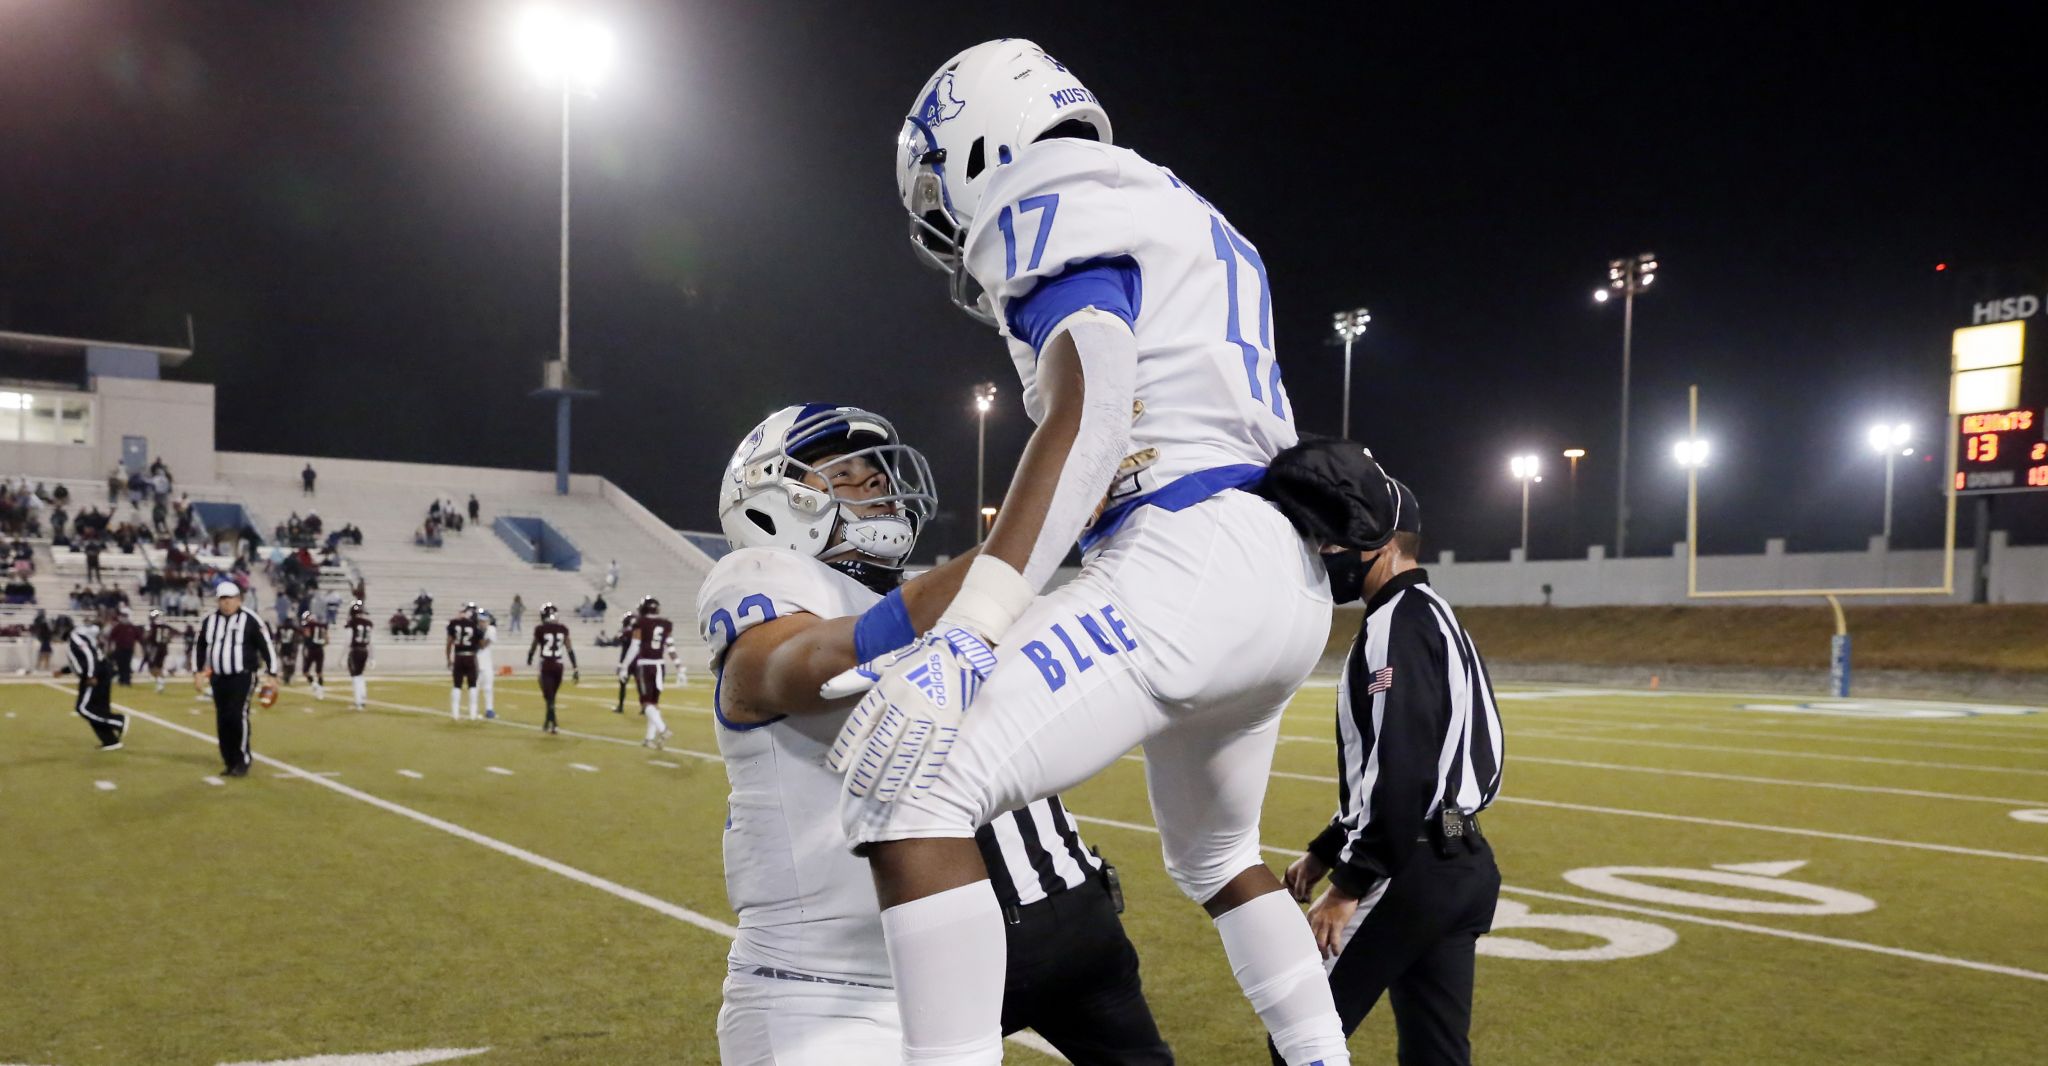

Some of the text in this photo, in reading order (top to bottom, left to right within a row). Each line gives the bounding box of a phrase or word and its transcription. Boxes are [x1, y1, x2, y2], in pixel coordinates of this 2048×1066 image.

[997, 193, 1060, 281] 17
[1972, 295, 2040, 325] HISD
[1967, 433, 1999, 462] 13
[1020, 603, 1138, 694] BLUE
[928, 653, 947, 707] adidas
